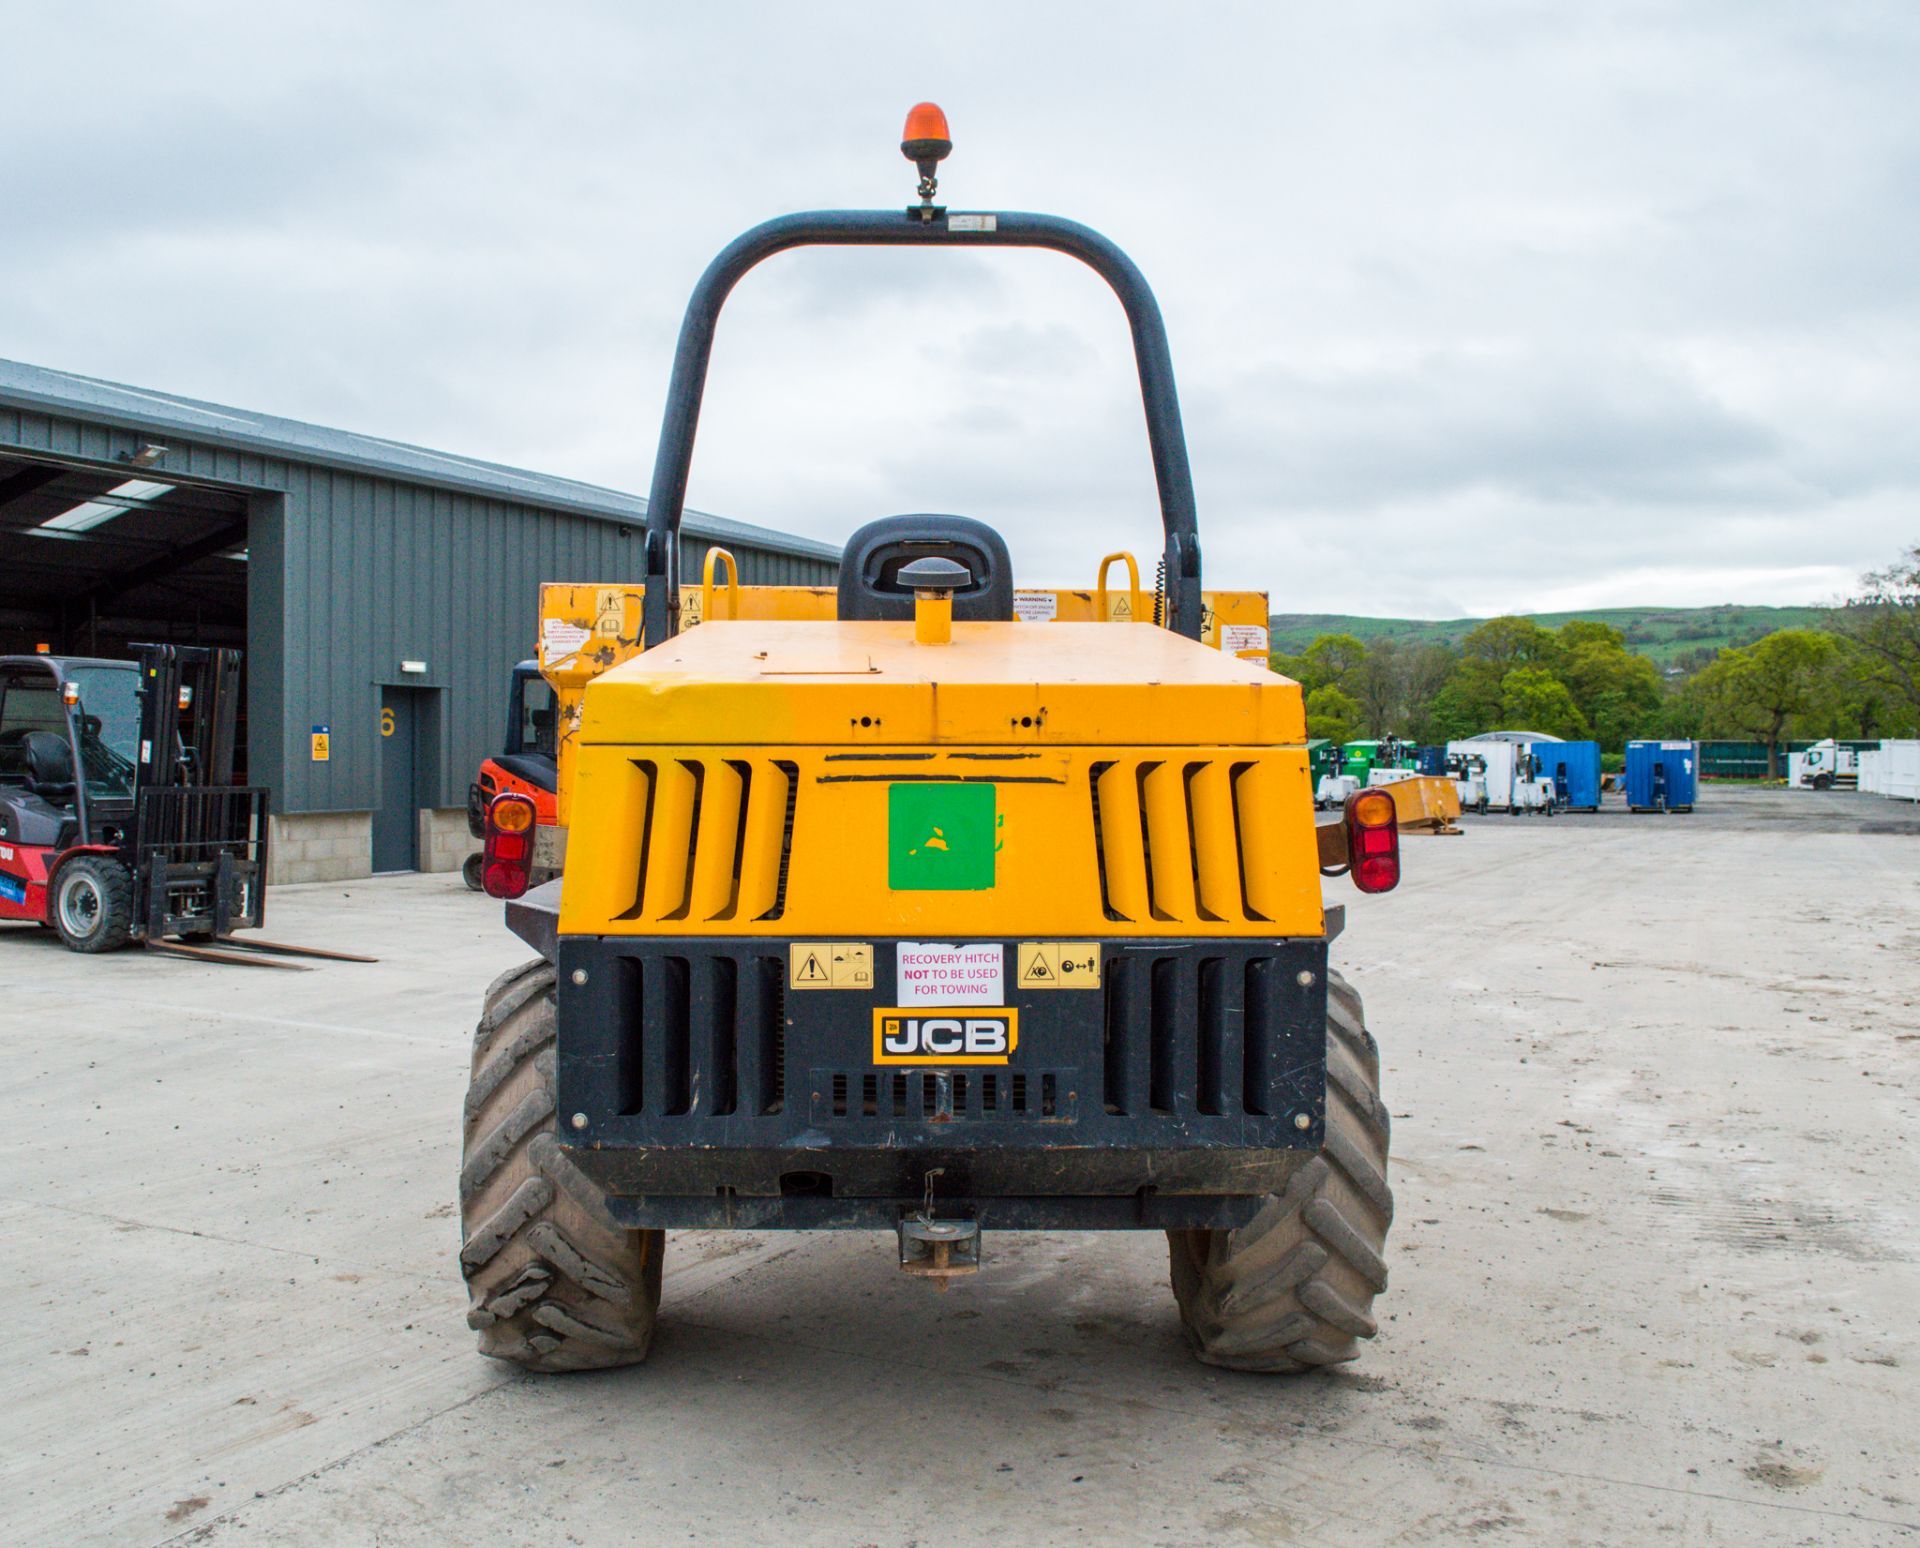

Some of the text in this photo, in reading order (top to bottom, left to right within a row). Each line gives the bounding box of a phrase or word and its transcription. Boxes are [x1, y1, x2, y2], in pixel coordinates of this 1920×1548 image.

[902, 953, 999, 964] RECOVERY HITCH
[904, 968, 998, 980] NOT TO BE USED
[914, 984, 988, 995] FOR TOWING
[885, 1019, 1006, 1053] JCB
